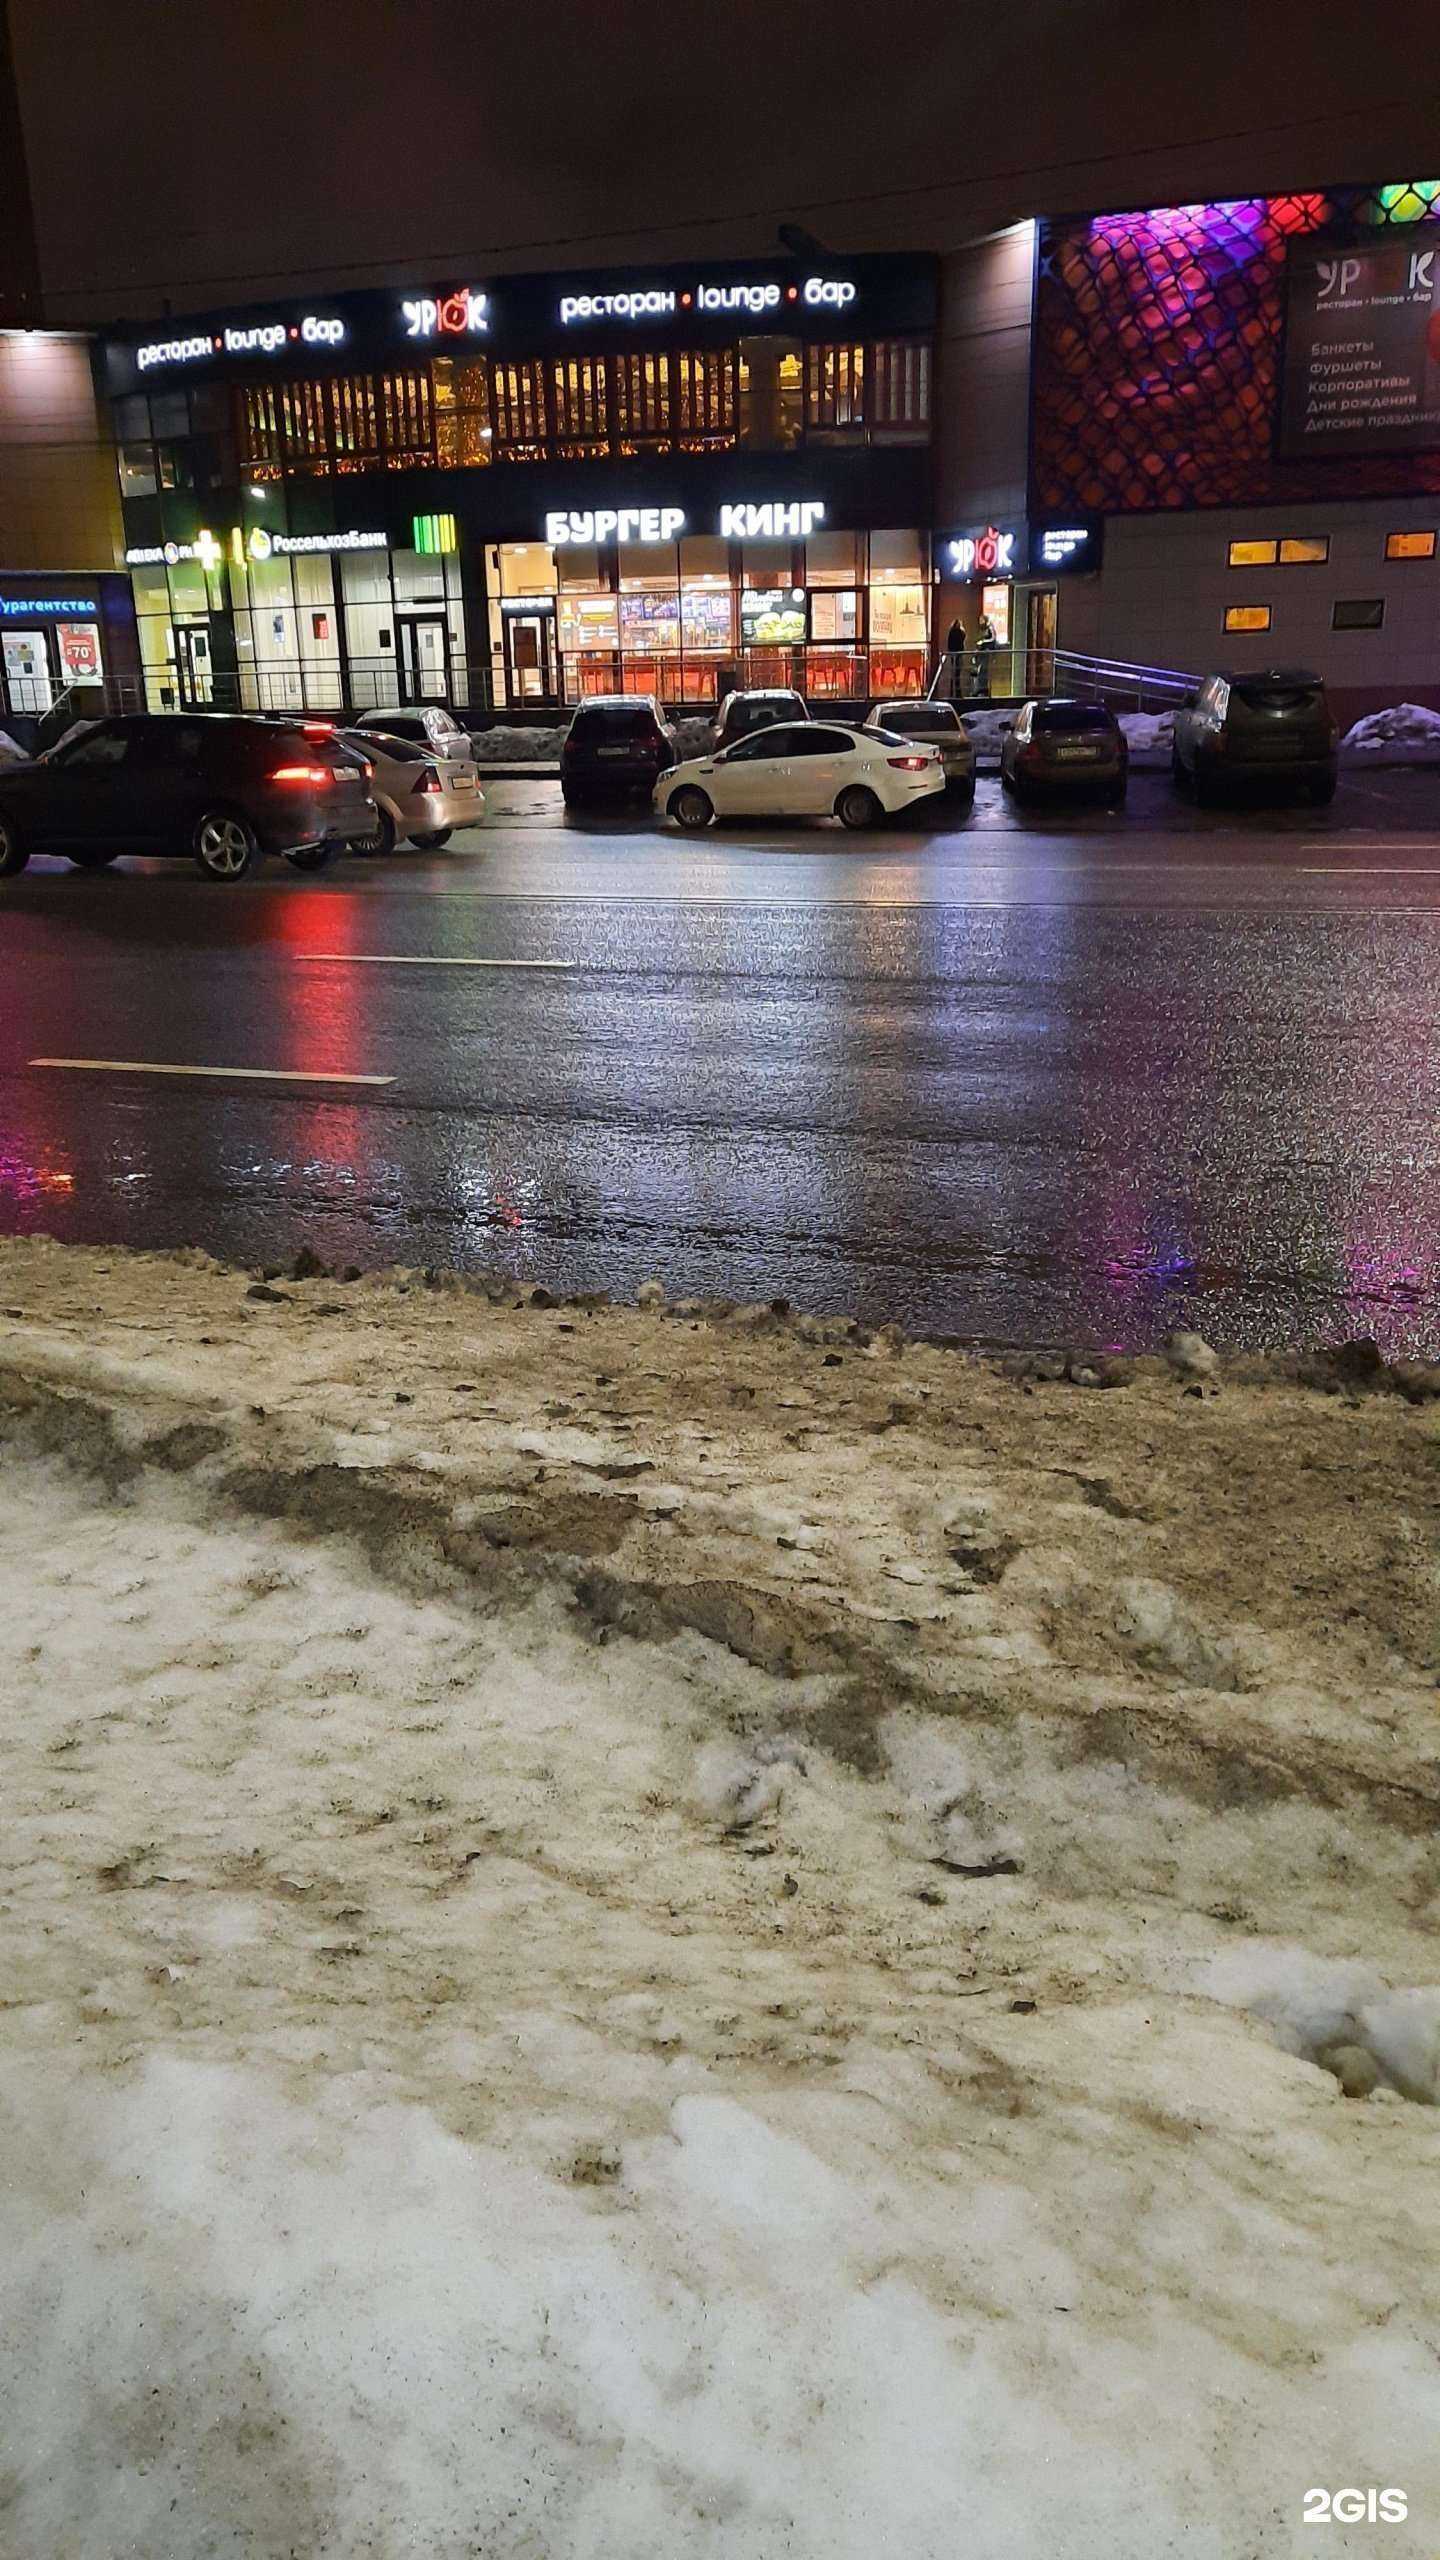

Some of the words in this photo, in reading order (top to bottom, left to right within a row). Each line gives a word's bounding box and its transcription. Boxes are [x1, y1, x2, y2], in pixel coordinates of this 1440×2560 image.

[560, 290, 675, 324] ресторан
[698, 283, 780, 311] lounge
[804, 278, 855, 308] бар
[137, 337, 212, 371] ресторан
[225, 324, 286, 351] lounge
[302, 317, 344, 344] бар
[1311, 341, 1374, 356] Банкеты
[1310, 360, 1382, 375] Фуршеты
[1308, 376, 1411, 393] Корпоративы
[1306, 401, 1336, 413] Дни
[1340, 394, 1417, 411] рождения
[546, 508, 685, 543] БУРГЕР
[720, 502, 825, 537] КИНГ
[273, 530, 387, 552] РоссельхозБанк
[0, 599, 96, 614] урагентство
